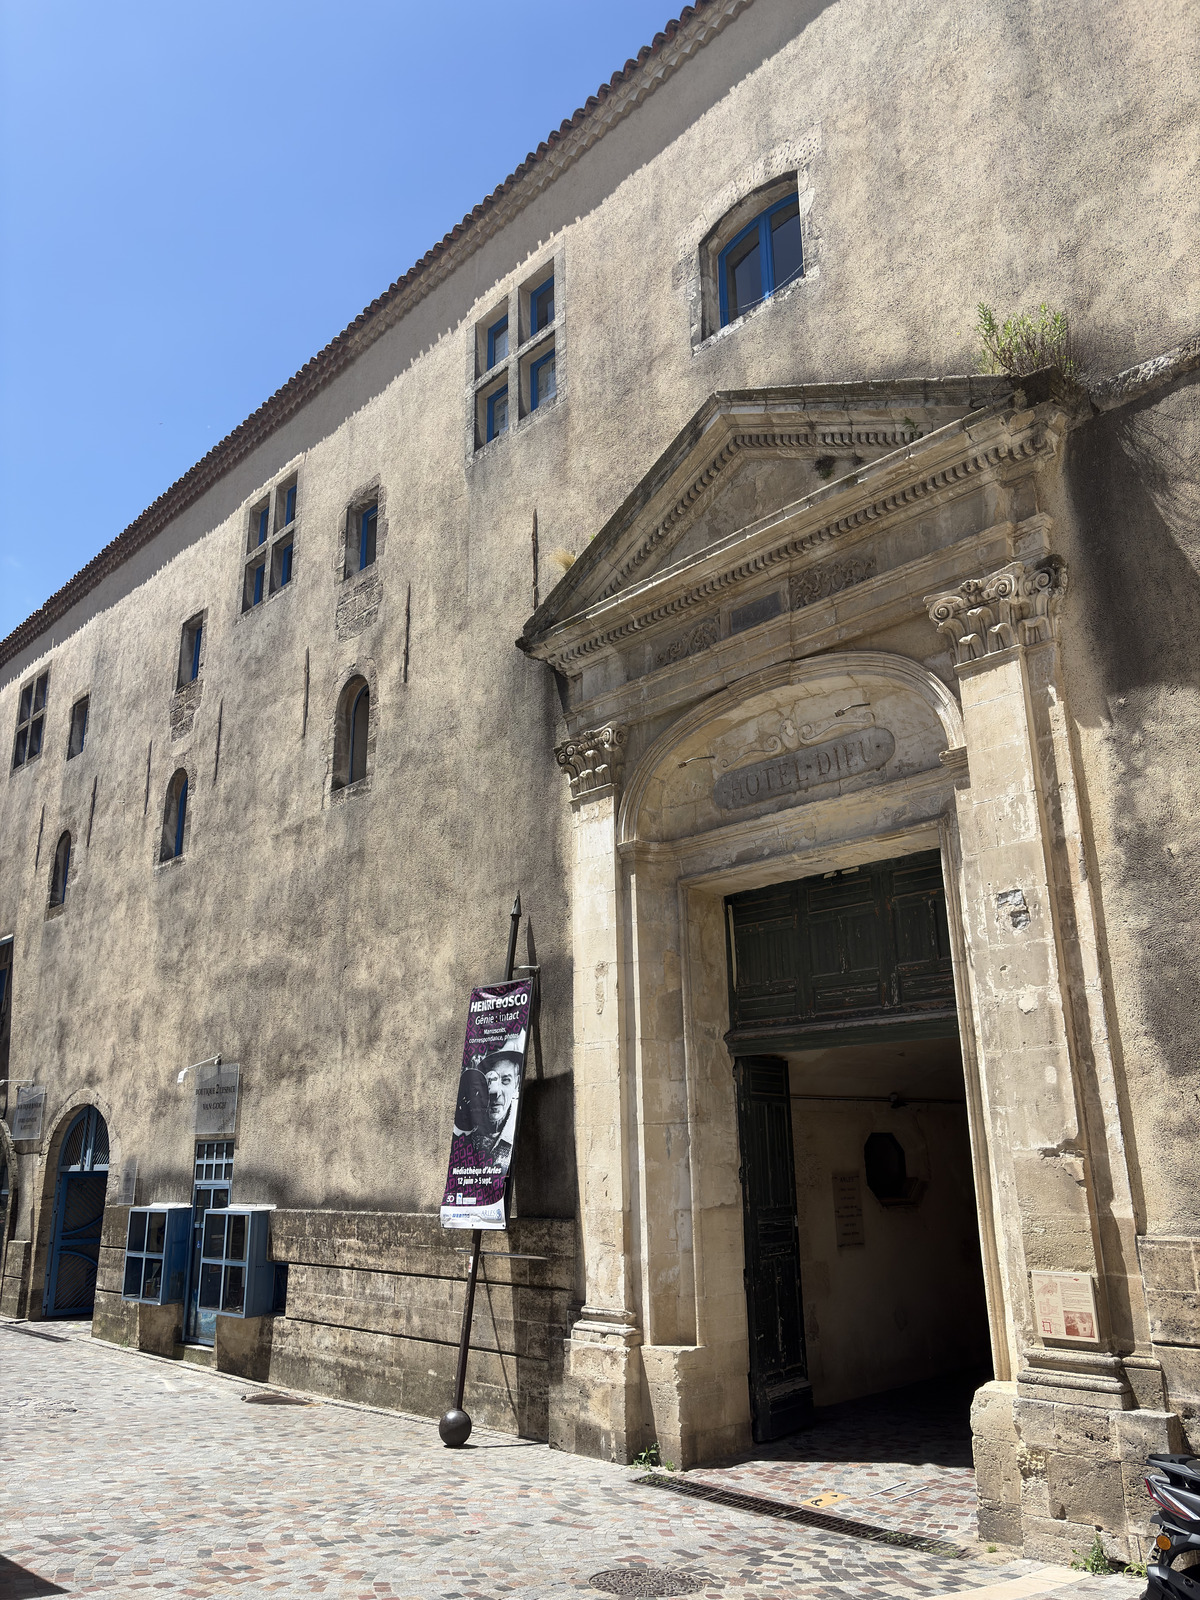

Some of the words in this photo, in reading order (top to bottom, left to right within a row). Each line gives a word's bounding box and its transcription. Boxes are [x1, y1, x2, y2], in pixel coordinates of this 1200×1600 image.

[475, 1014, 494, 1025] Génie
[499, 1010, 519, 1022] intact
[453, 1166, 482, 1176] Médiathèqu
